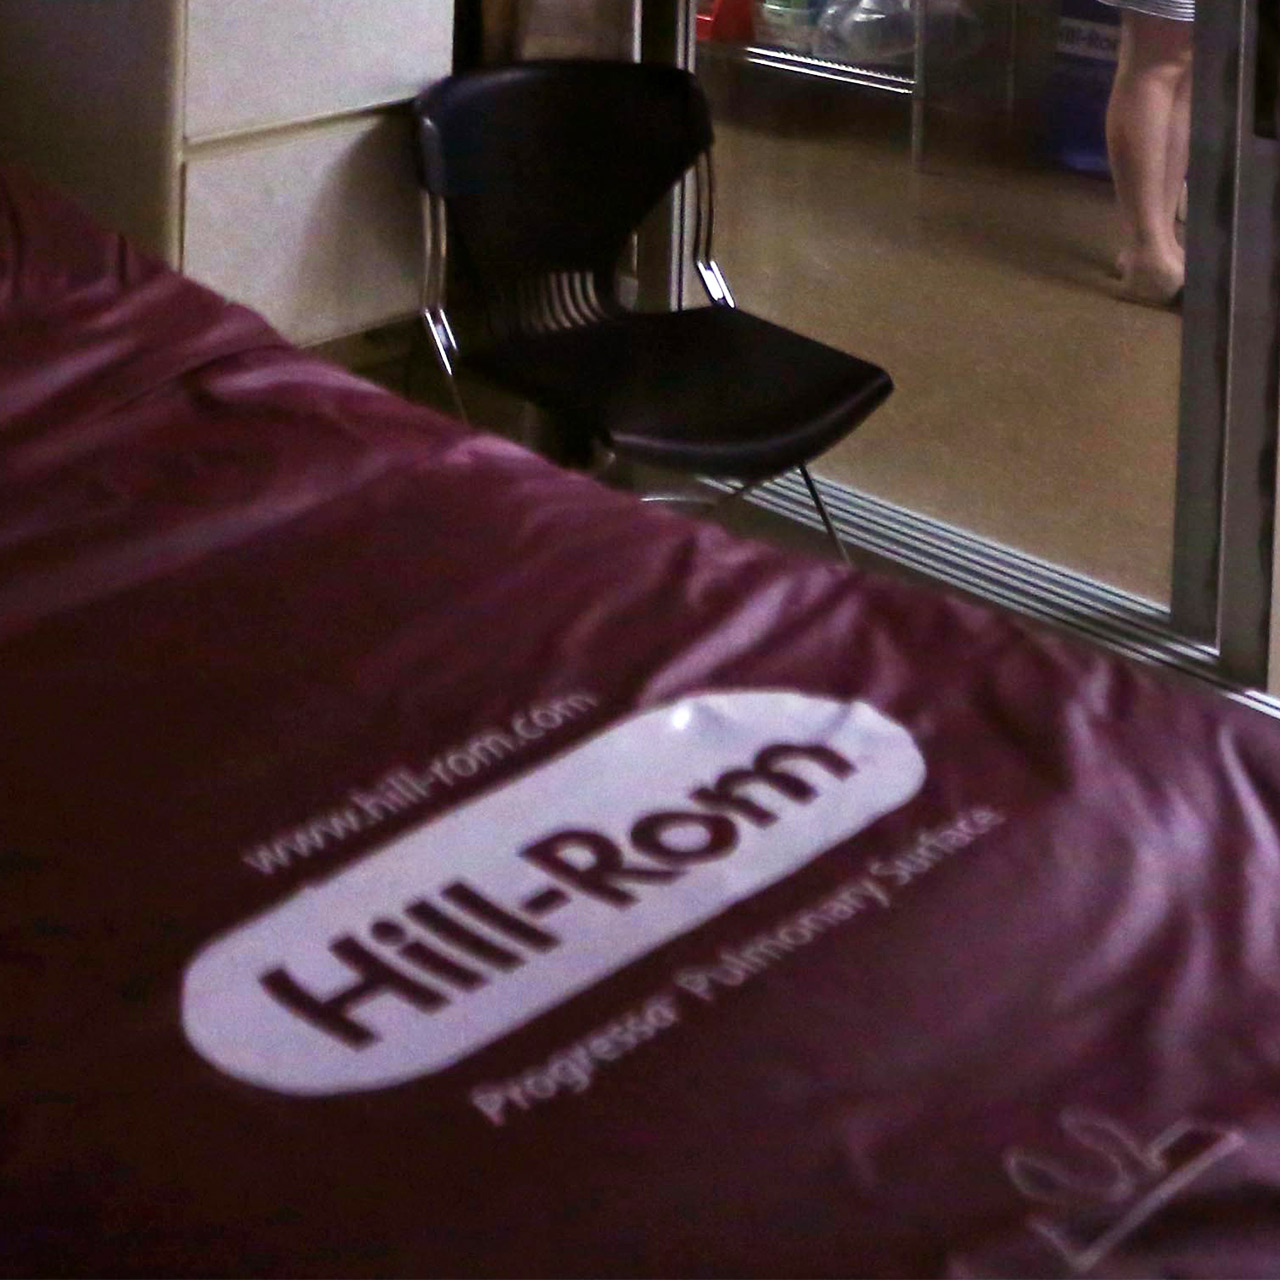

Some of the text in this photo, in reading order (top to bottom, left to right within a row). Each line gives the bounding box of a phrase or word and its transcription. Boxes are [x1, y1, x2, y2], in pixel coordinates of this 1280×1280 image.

[242, 693, 600, 876] www.hill-rom.com
[257, 741, 858, 1053] Hill-Rom
[674, 875, 891, 1002] Pulmonary
[869, 807, 1005, 886] Surface
